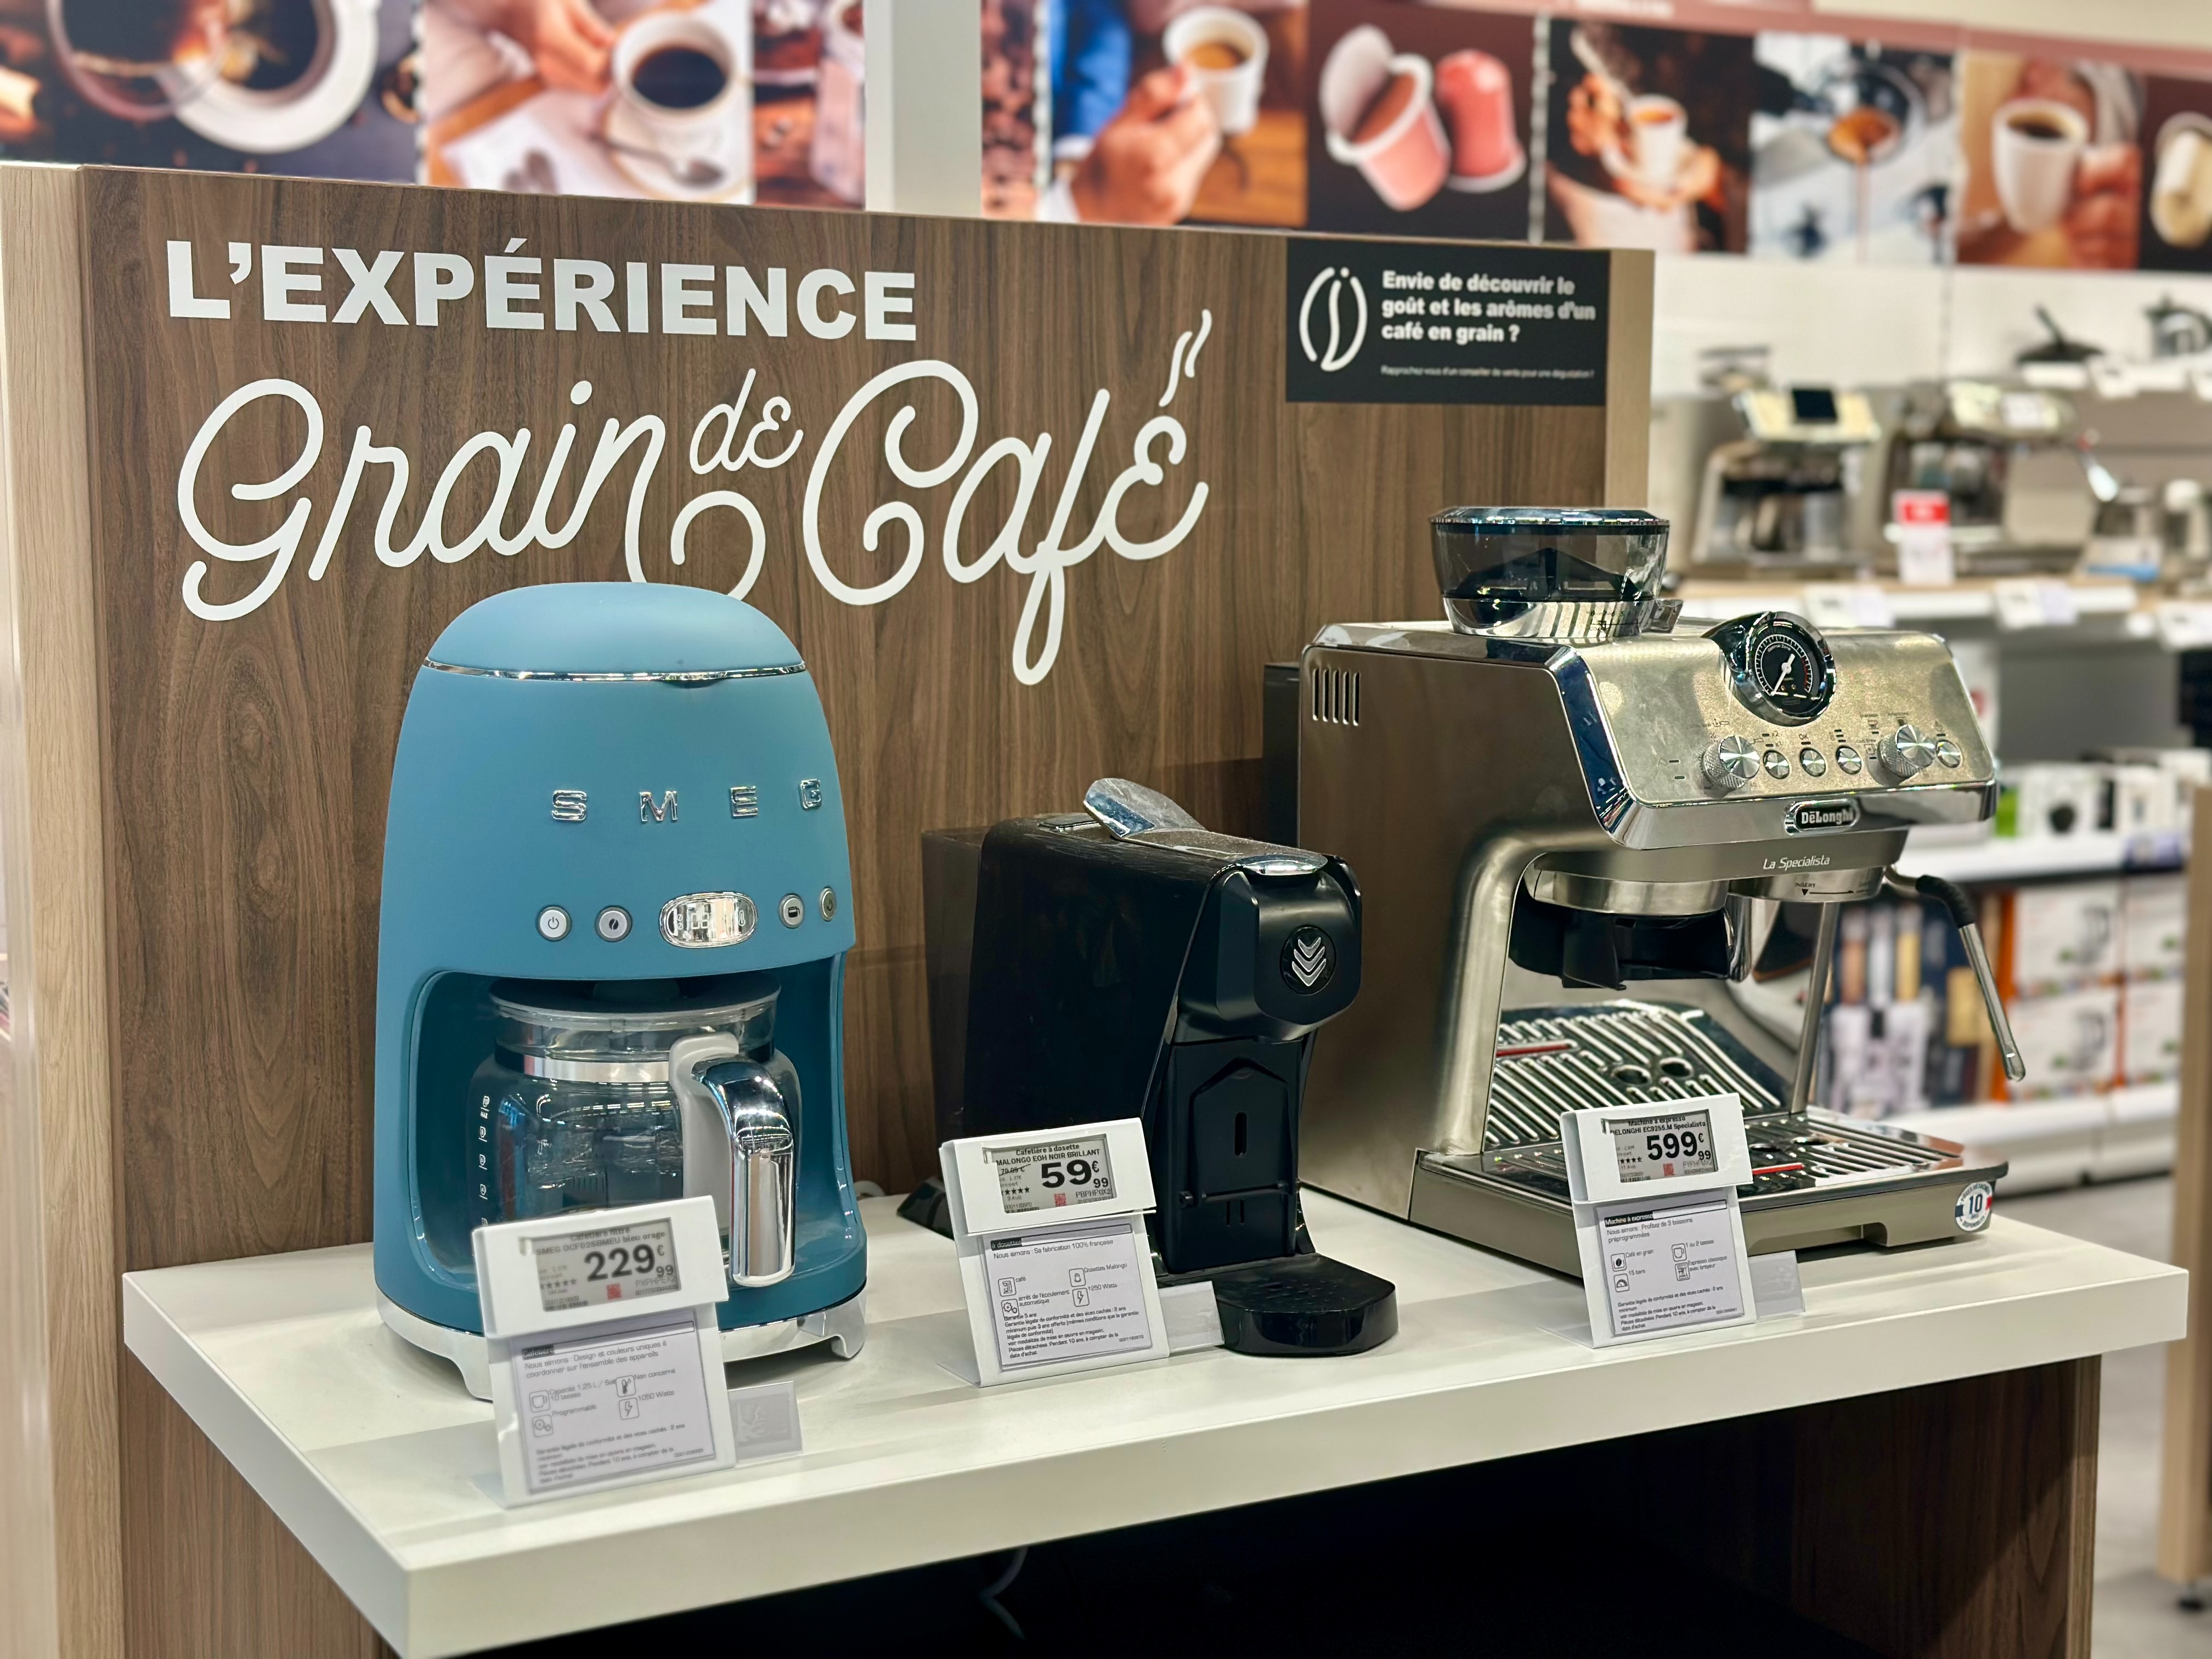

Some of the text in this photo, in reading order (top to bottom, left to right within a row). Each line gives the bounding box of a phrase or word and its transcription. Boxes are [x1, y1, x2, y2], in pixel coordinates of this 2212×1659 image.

[1383, 270, 1575, 295] Envie de découvrir le
[166, 238, 916, 342] L'EXPÉRIENCE
[1381, 296, 1595, 320] goût et les arômes d'un
[1381, 321, 1520, 345] café en grain ?
[177, 378, 765, 621] Grain
[803, 309, 1209, 685] Café
[551, 778, 822, 822] SMEG
[1763, 855, 1830, 871] La Specialista
[1674, 1121, 1706, 1131] Specialista
[1016, 1147, 1047, 1156] Cafetière
[1054, 1143, 1080, 1152] dosette
[1647, 1131, 1703, 1160] 599 €
[996, 1156, 1031, 1166] MALONGO
[1049, 1152, 1066, 1160] NOIR
[1068, 1149, 1100, 1158] BRILLANT
[1698, 1150, 1711, 1160] 99
[1041, 1159, 1099, 1188] 59 €
[1093, 1178, 1109, 1188] 99
[1970, 1193, 1983, 1214] 10
[1632, 1214, 1654, 1222] expresso
[571, 1229, 608, 1242] Cafetière
[1608, 1232, 1650, 1244] préprogrammées
[536, 1246, 561, 1255] SMEG
[623, 1234, 640, 1243] bleu
[643, 1231, 665, 1242] orage
[1042, 1244, 1071, 1252] fabrication
[1089, 1239, 1114, 1248] française
[584, 1244, 665, 1282] 229 €
[656, 1265, 674, 1277] 99
[1040, 1289, 1070, 1299] l'écoulement
[1019, 1298, 1049, 1307] automatique
[1046, 1313, 1070, 1322] conformité
[545, 1358, 569, 1366] aimons
[574, 1353, 596, 1362] Design
[607, 1346, 634, 1356] couleurs
[636, 1342, 661, 1352] uniques
[526, 1368, 566, 1378] coordonner
[579, 1358, 614, 1369] l'ensemble
[616, 1356, 628, 1364] des
[629, 1351, 659, 1362] appareils
[648, 1369, 675, 1378] concerné
[549, 1385, 575, 1395] Capacité
[638, 1390, 675, 1402] 1050 Watts
[552, 1404, 597, 1417] Programmable
